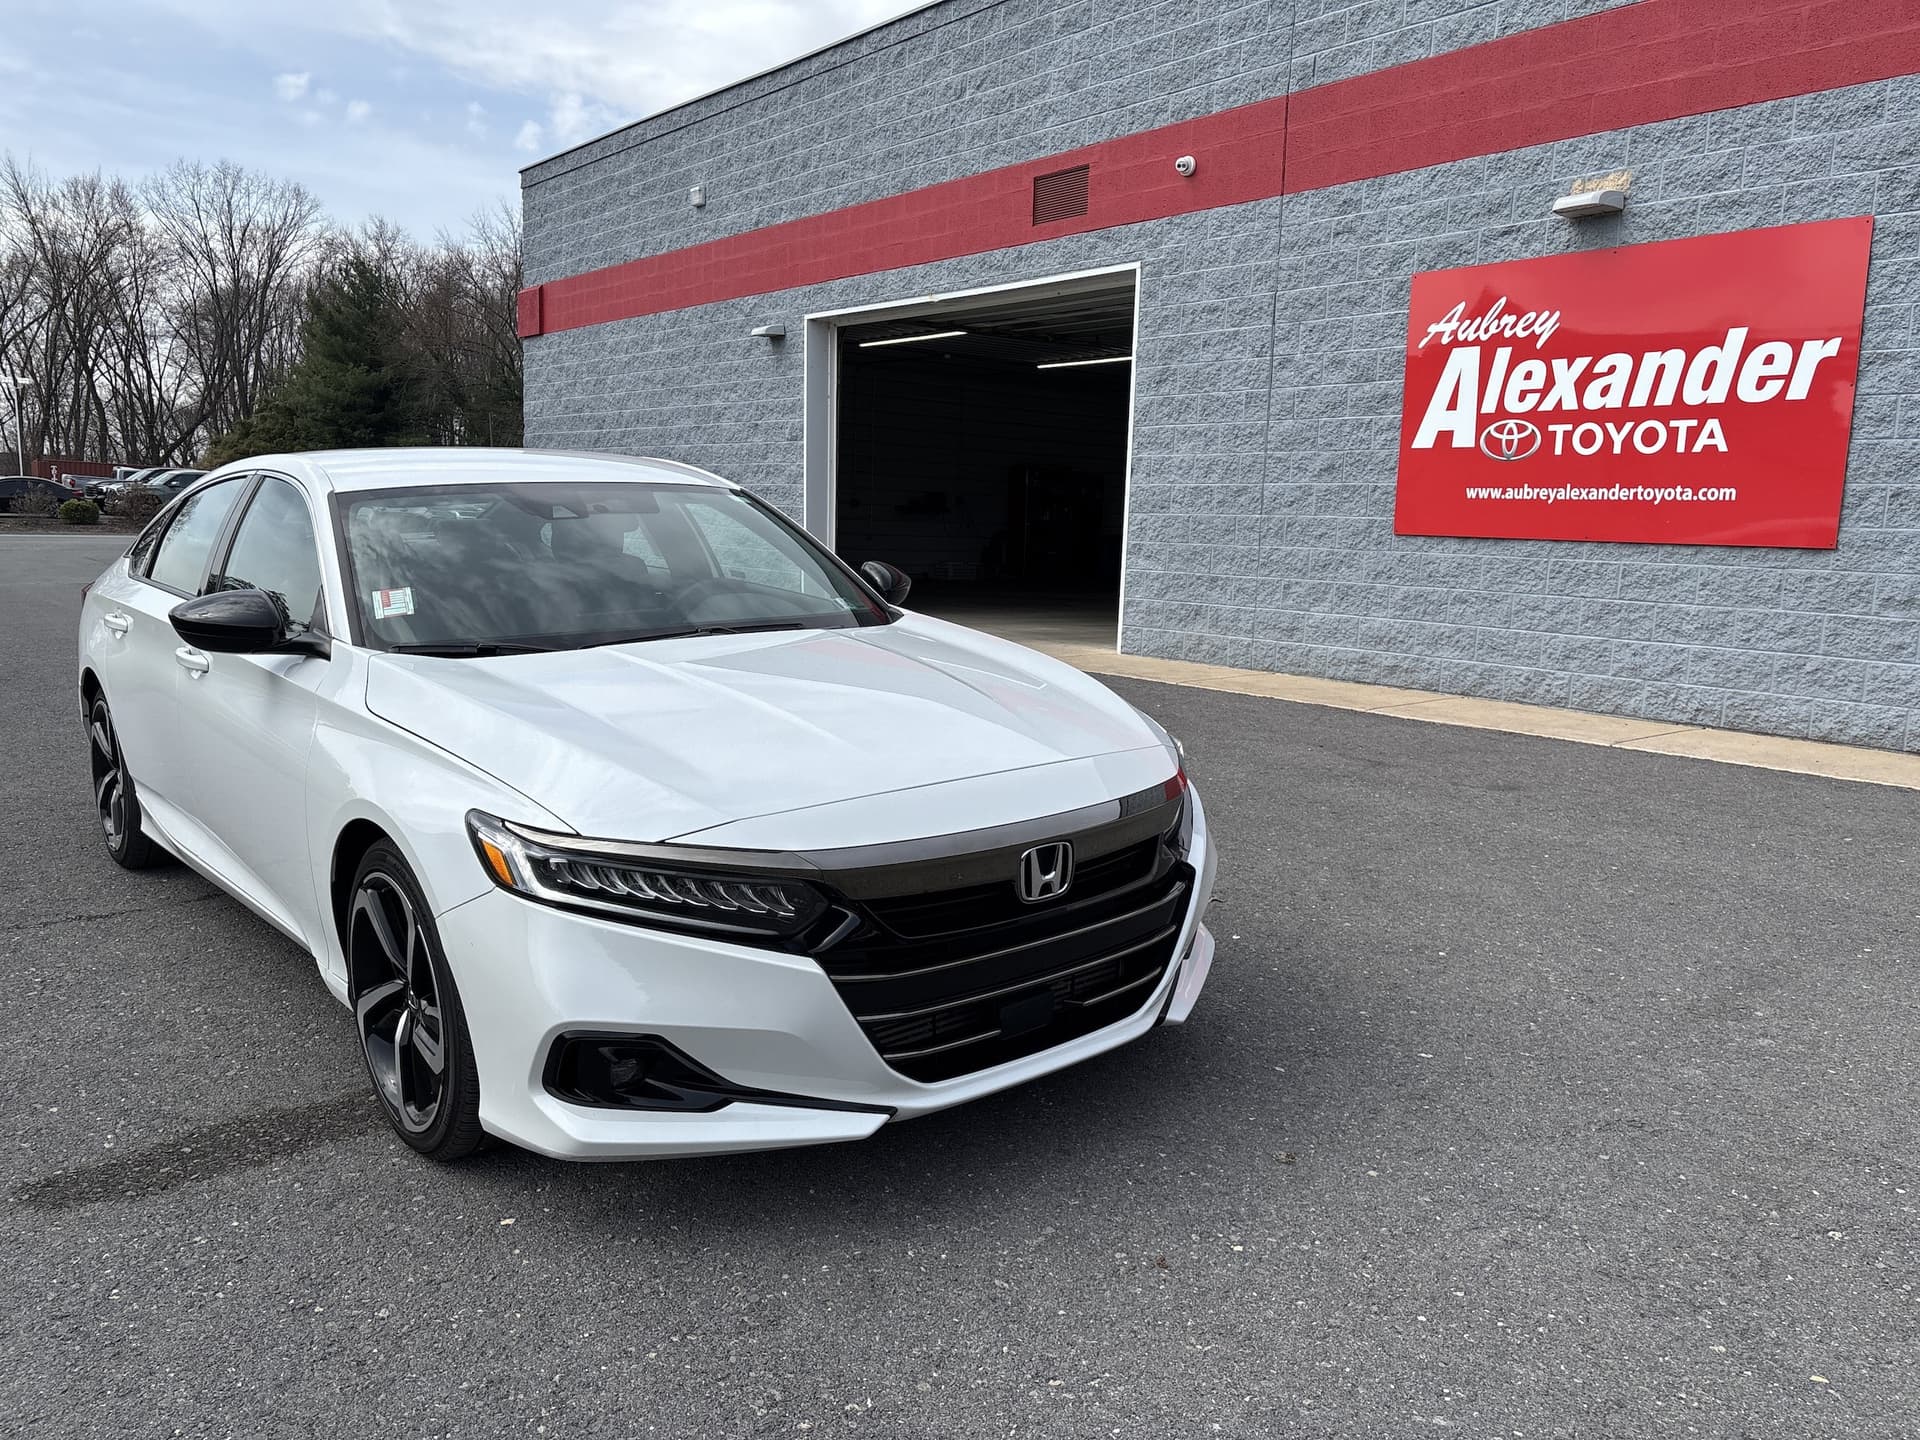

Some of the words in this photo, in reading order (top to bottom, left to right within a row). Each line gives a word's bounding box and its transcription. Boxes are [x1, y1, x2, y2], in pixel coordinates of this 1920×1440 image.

[1417, 296, 1561, 350] Aubrey
[1411, 326, 1843, 449] Alexander
[1547, 418, 1729, 456] TOYOTA
[1465, 483, 1737, 505] www.aubreyalexandertoyota.com
